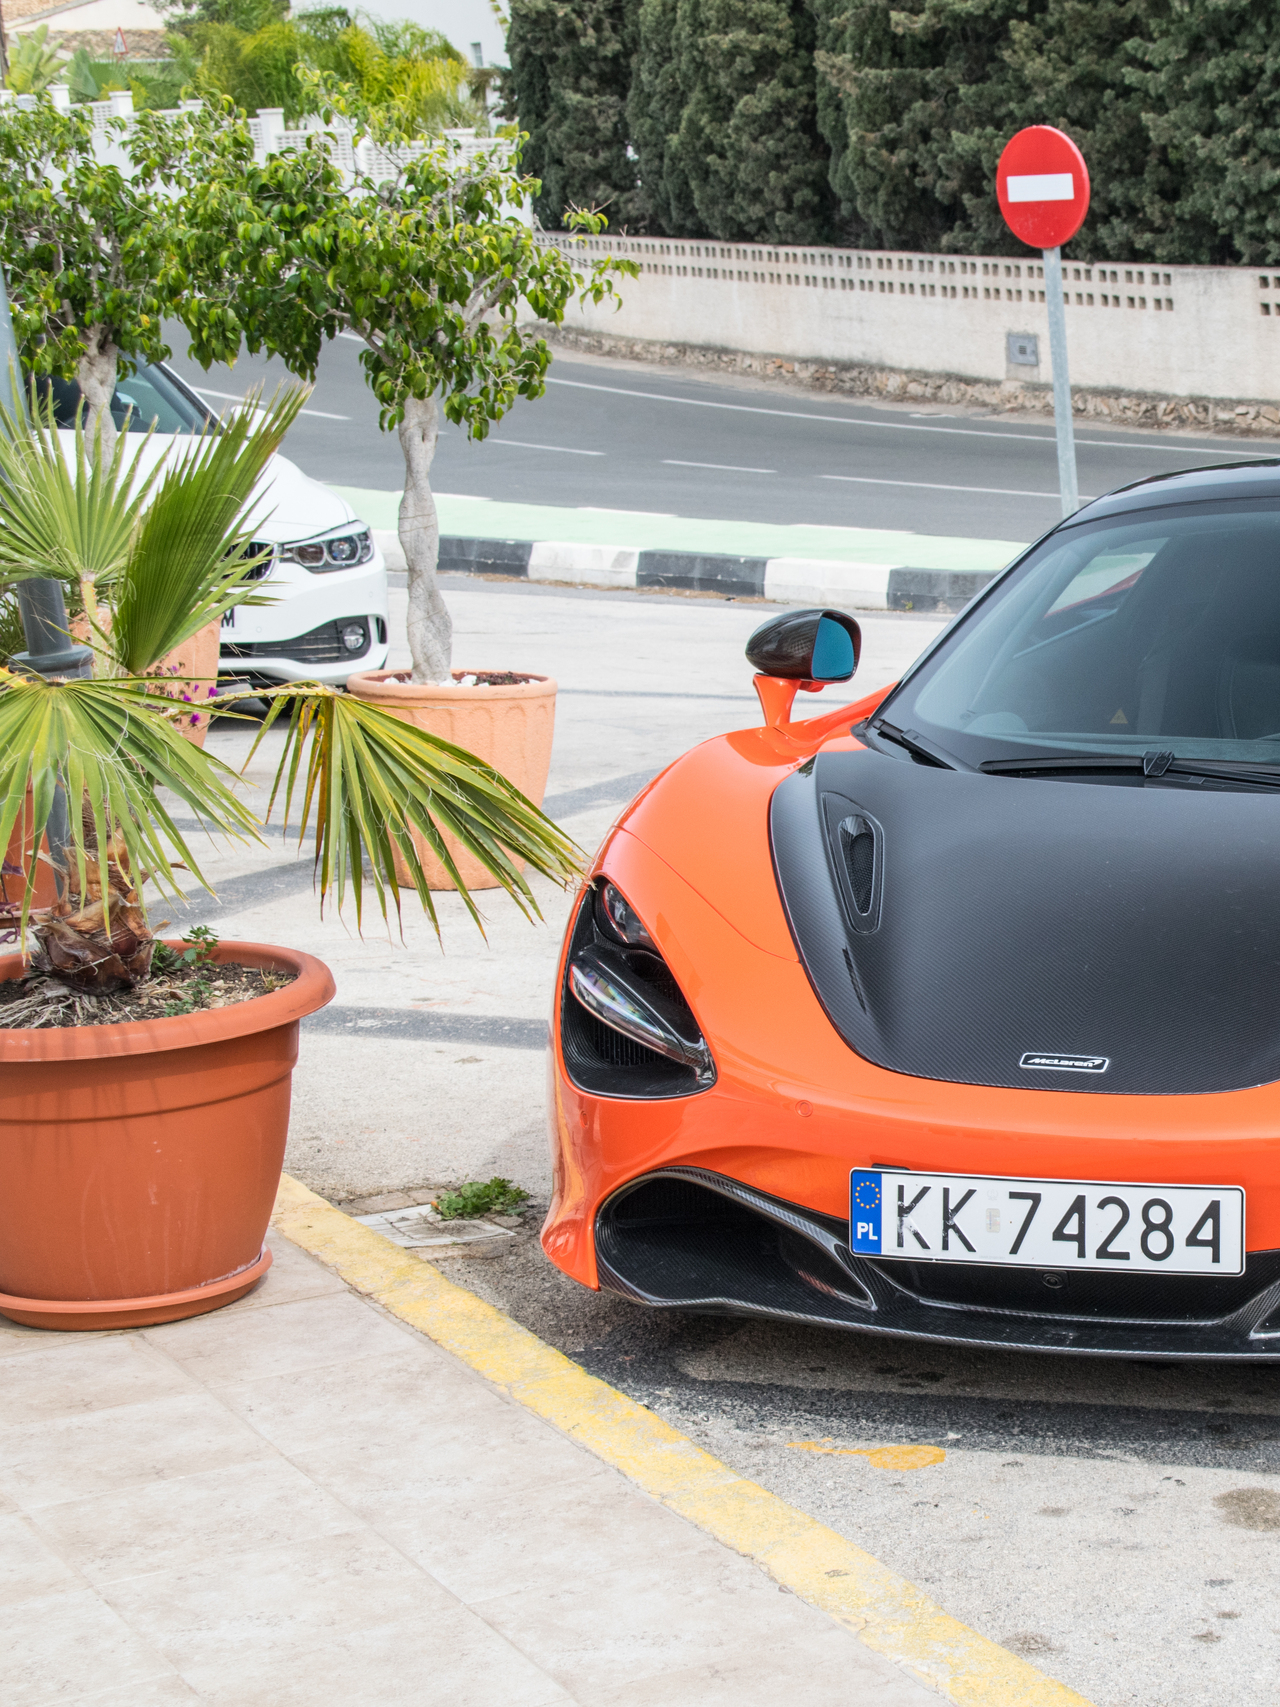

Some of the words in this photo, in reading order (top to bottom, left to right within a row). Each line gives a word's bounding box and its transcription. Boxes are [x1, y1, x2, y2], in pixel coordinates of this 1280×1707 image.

[1027, 1058, 1101, 1068] McLaren
[857, 1222, 878, 1241] PL
[896, 1184, 977, 1252] KK
[1008, 1191, 1221, 1263] 74284
